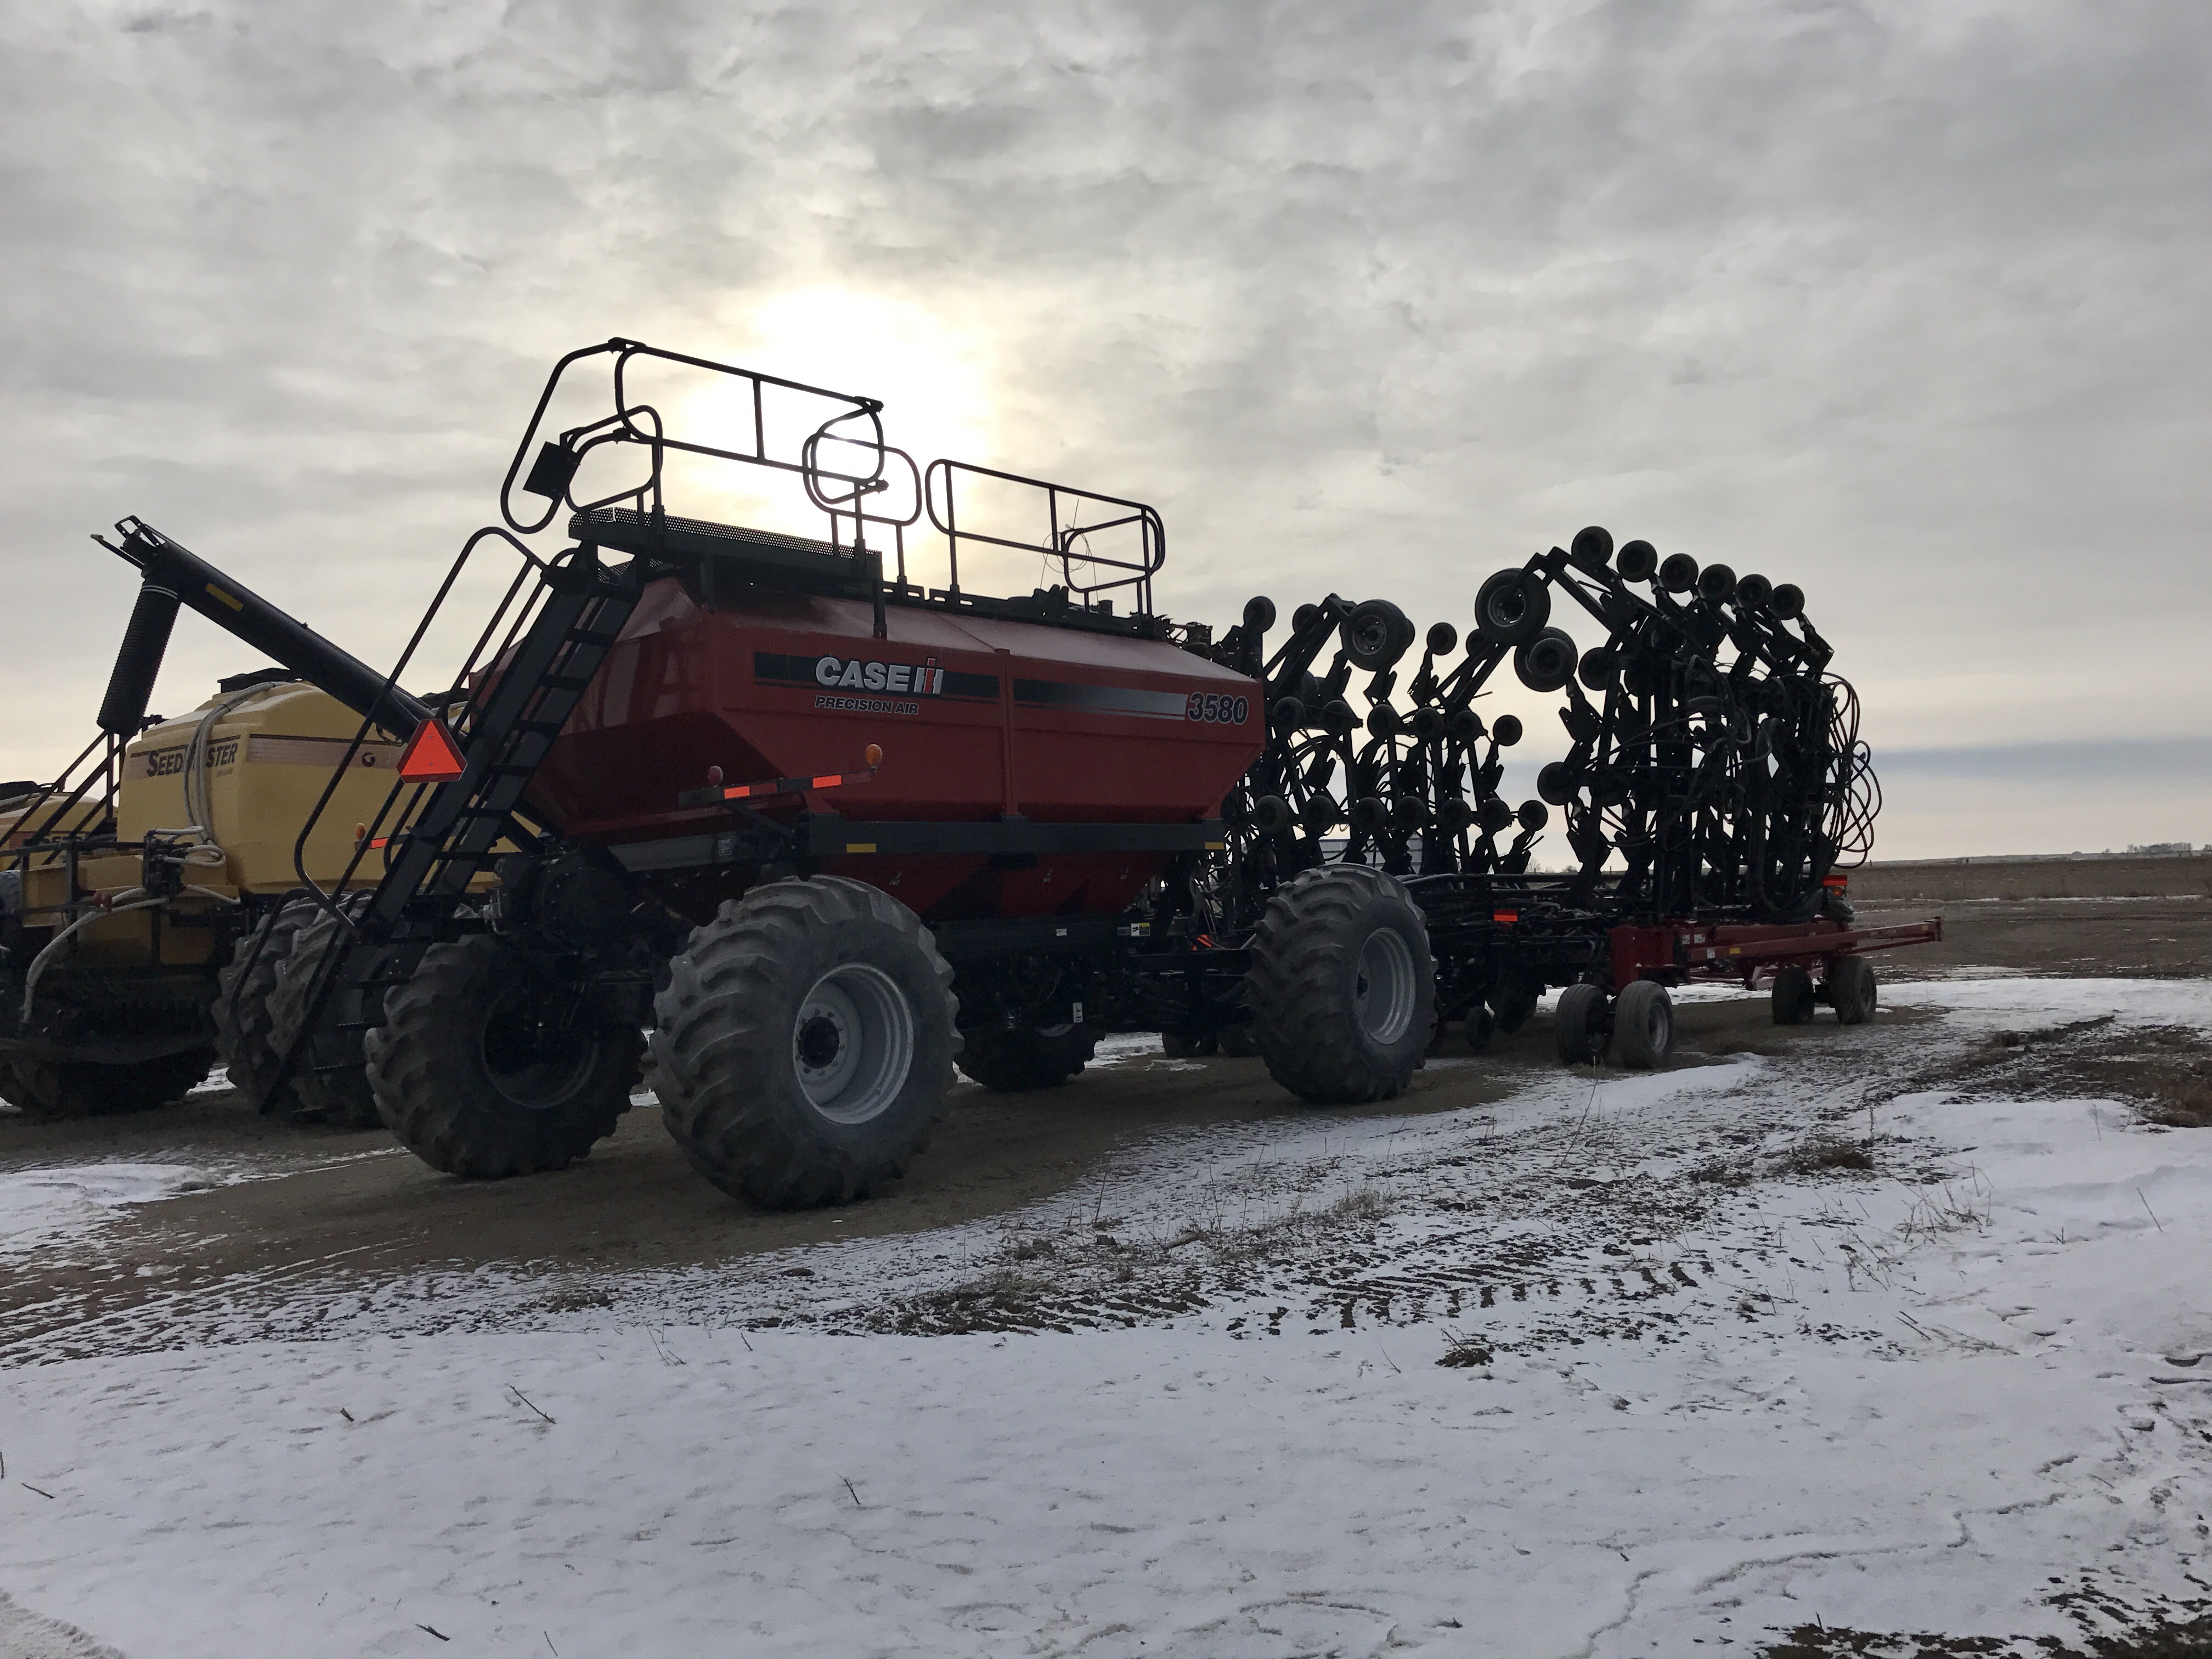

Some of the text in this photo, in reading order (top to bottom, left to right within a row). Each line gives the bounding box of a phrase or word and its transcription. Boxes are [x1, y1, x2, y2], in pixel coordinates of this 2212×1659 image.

[816, 657, 911, 692] CASE
[815, 695, 919, 715] PRECISION AIR
[1188, 691, 1249, 725] 3580
